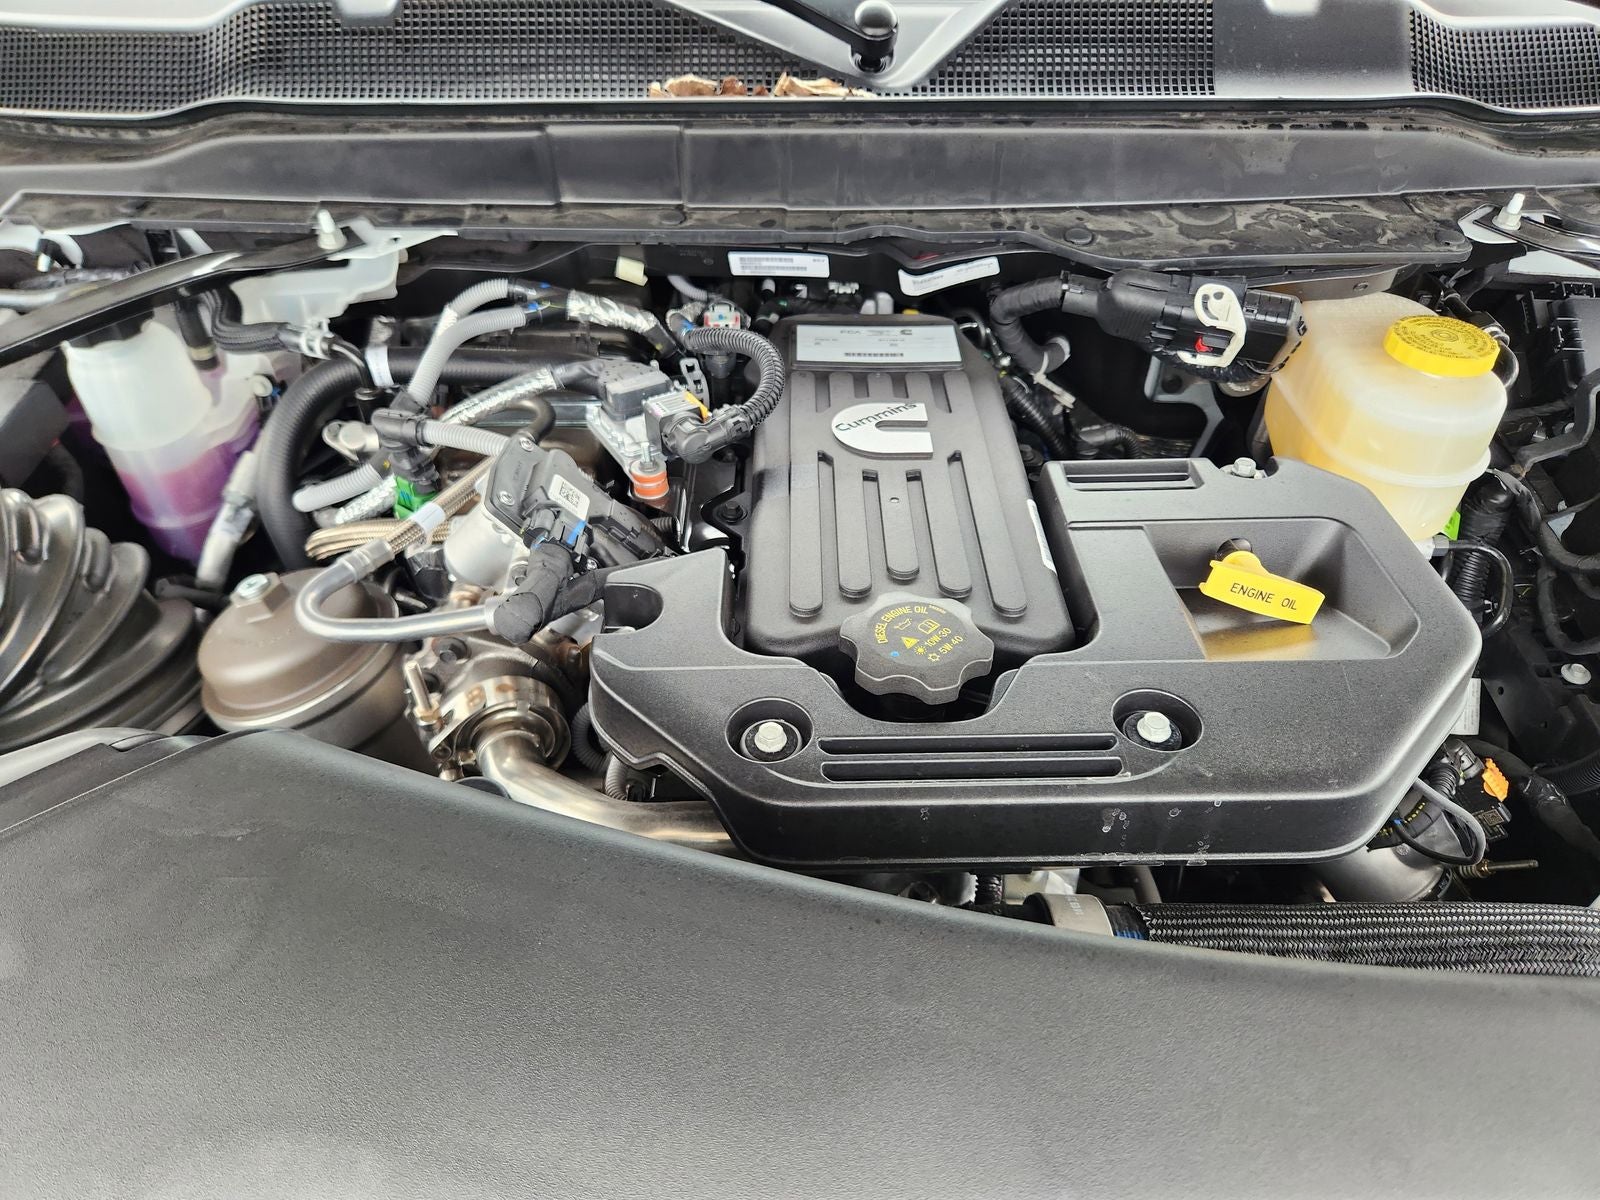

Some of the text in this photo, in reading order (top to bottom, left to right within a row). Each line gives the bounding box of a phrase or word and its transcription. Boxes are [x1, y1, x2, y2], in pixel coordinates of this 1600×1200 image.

[835, 402, 918, 432] Cummins
[1230, 582, 1297, 610] ENGINE OIL
[881, 606, 913, 623] ENGINE
[914, 606, 928, 615] OIL
[925, 627, 952, 647] 10W-30
[938, 635, 963, 655] 5W-40
